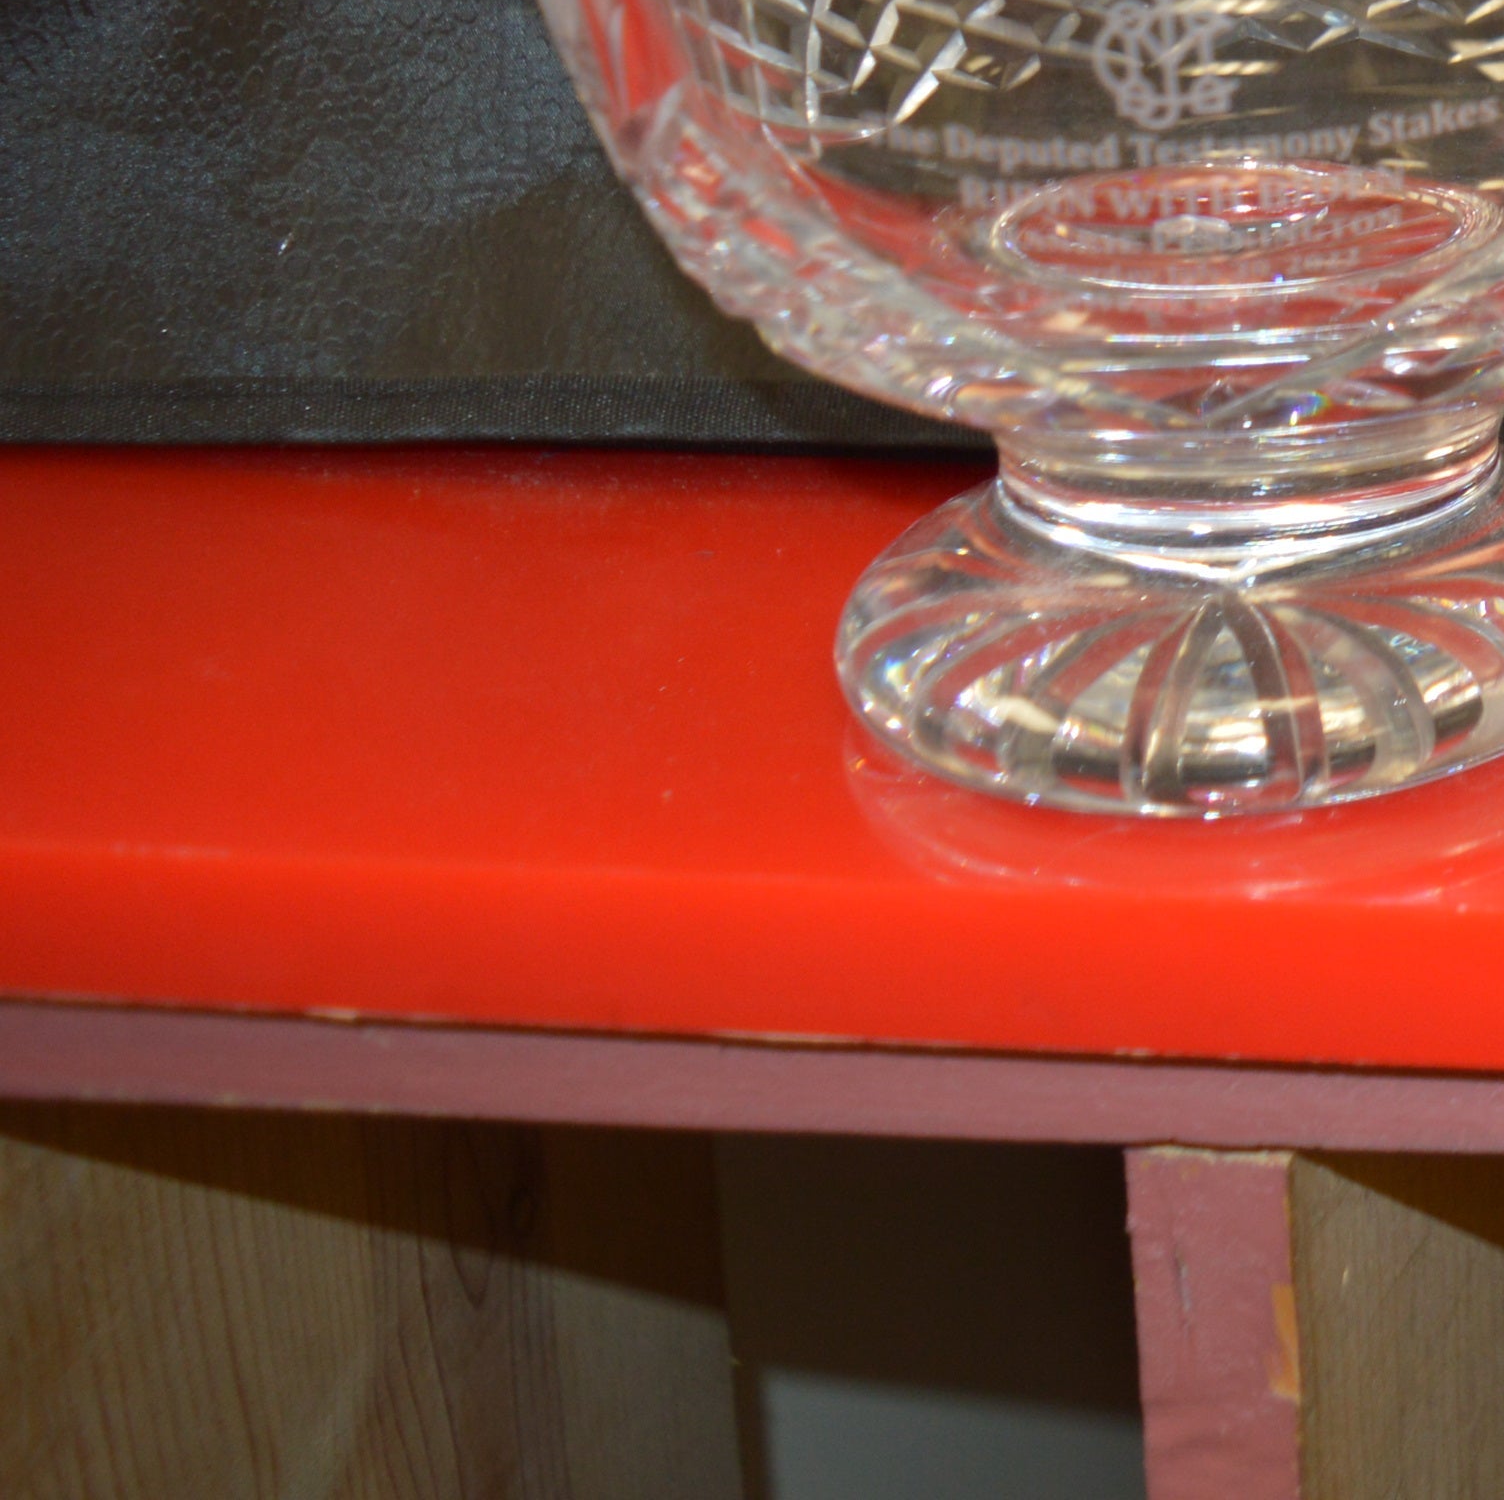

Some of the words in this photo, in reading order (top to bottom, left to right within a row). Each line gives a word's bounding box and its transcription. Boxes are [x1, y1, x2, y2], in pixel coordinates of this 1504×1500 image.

[942, 122, 1119, 172] Deputed
[1127, 124, 1360, 167] Testamony
[1368, 97, 1502, 147] Stakes
